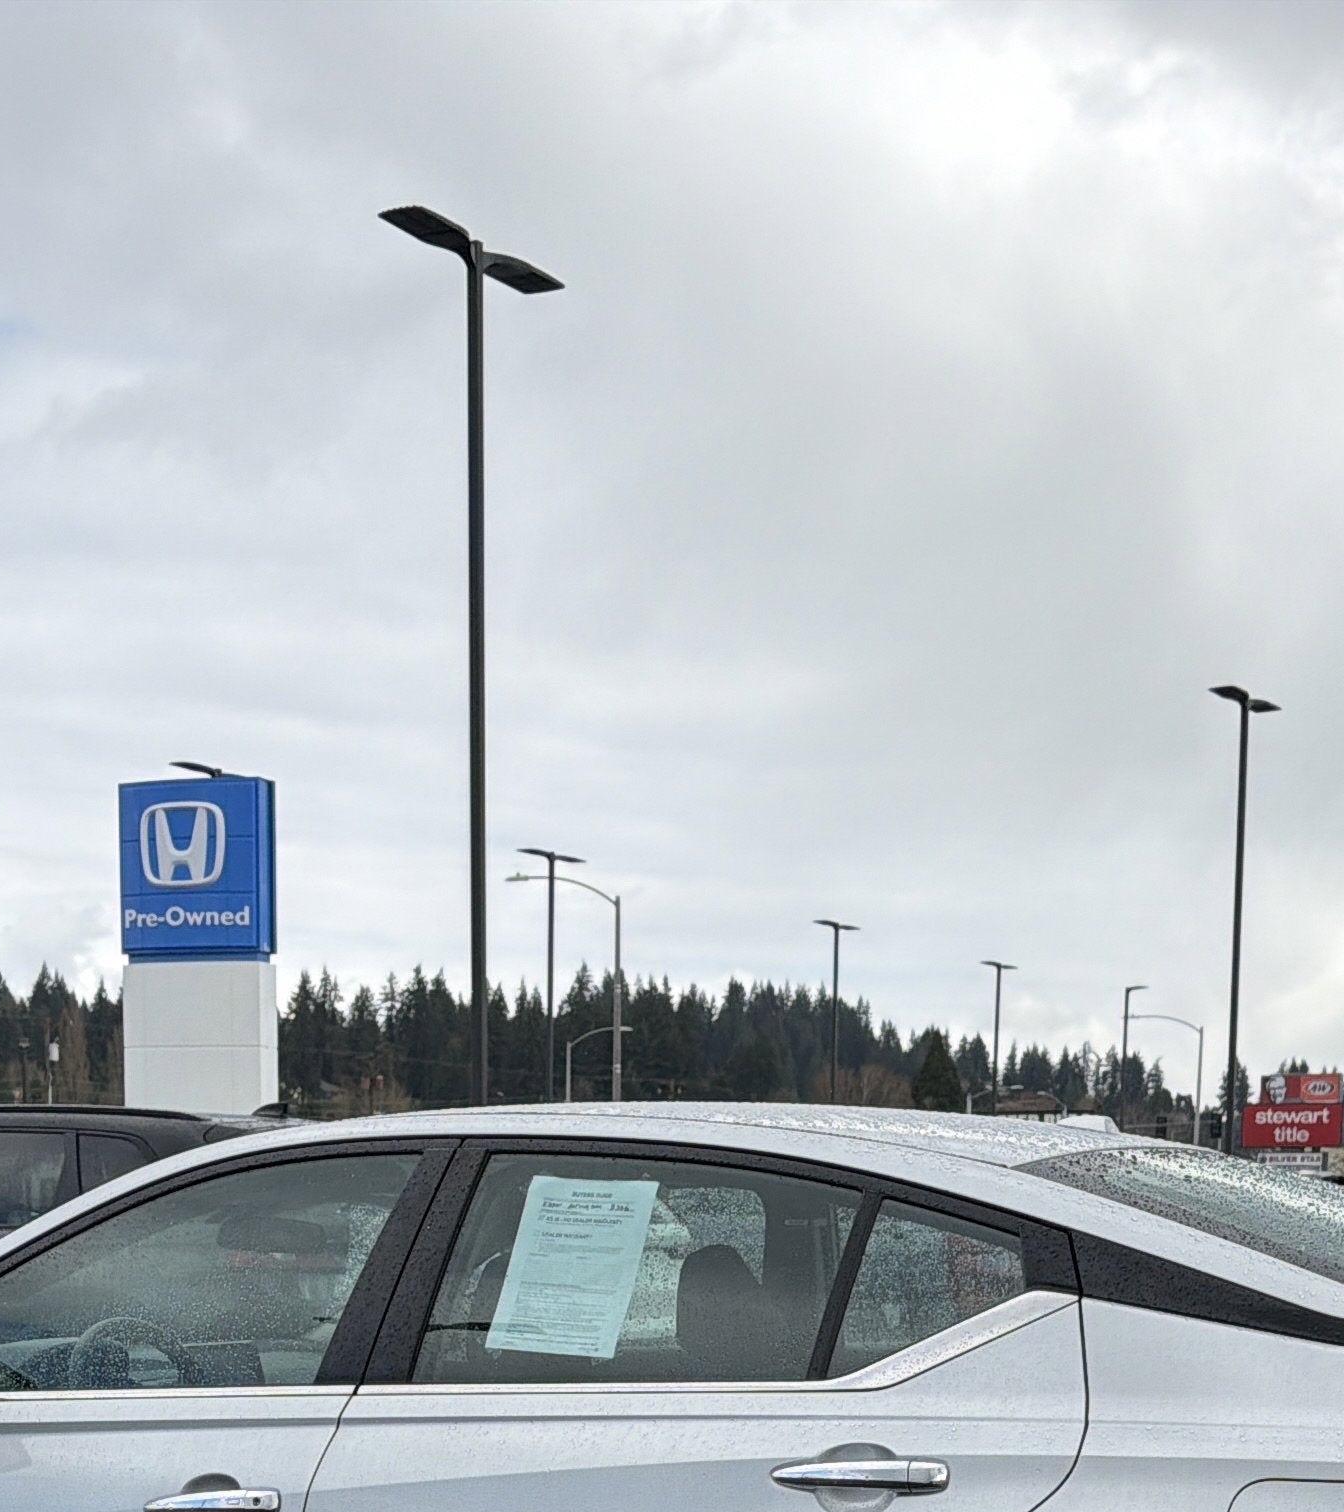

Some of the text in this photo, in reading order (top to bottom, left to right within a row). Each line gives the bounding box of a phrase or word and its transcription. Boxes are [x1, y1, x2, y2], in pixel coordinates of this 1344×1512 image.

[124, 906, 250, 929] Pre-Owned
[1255, 1107, 1330, 1125] stewart
[1273, 1126, 1310, 1143] title
